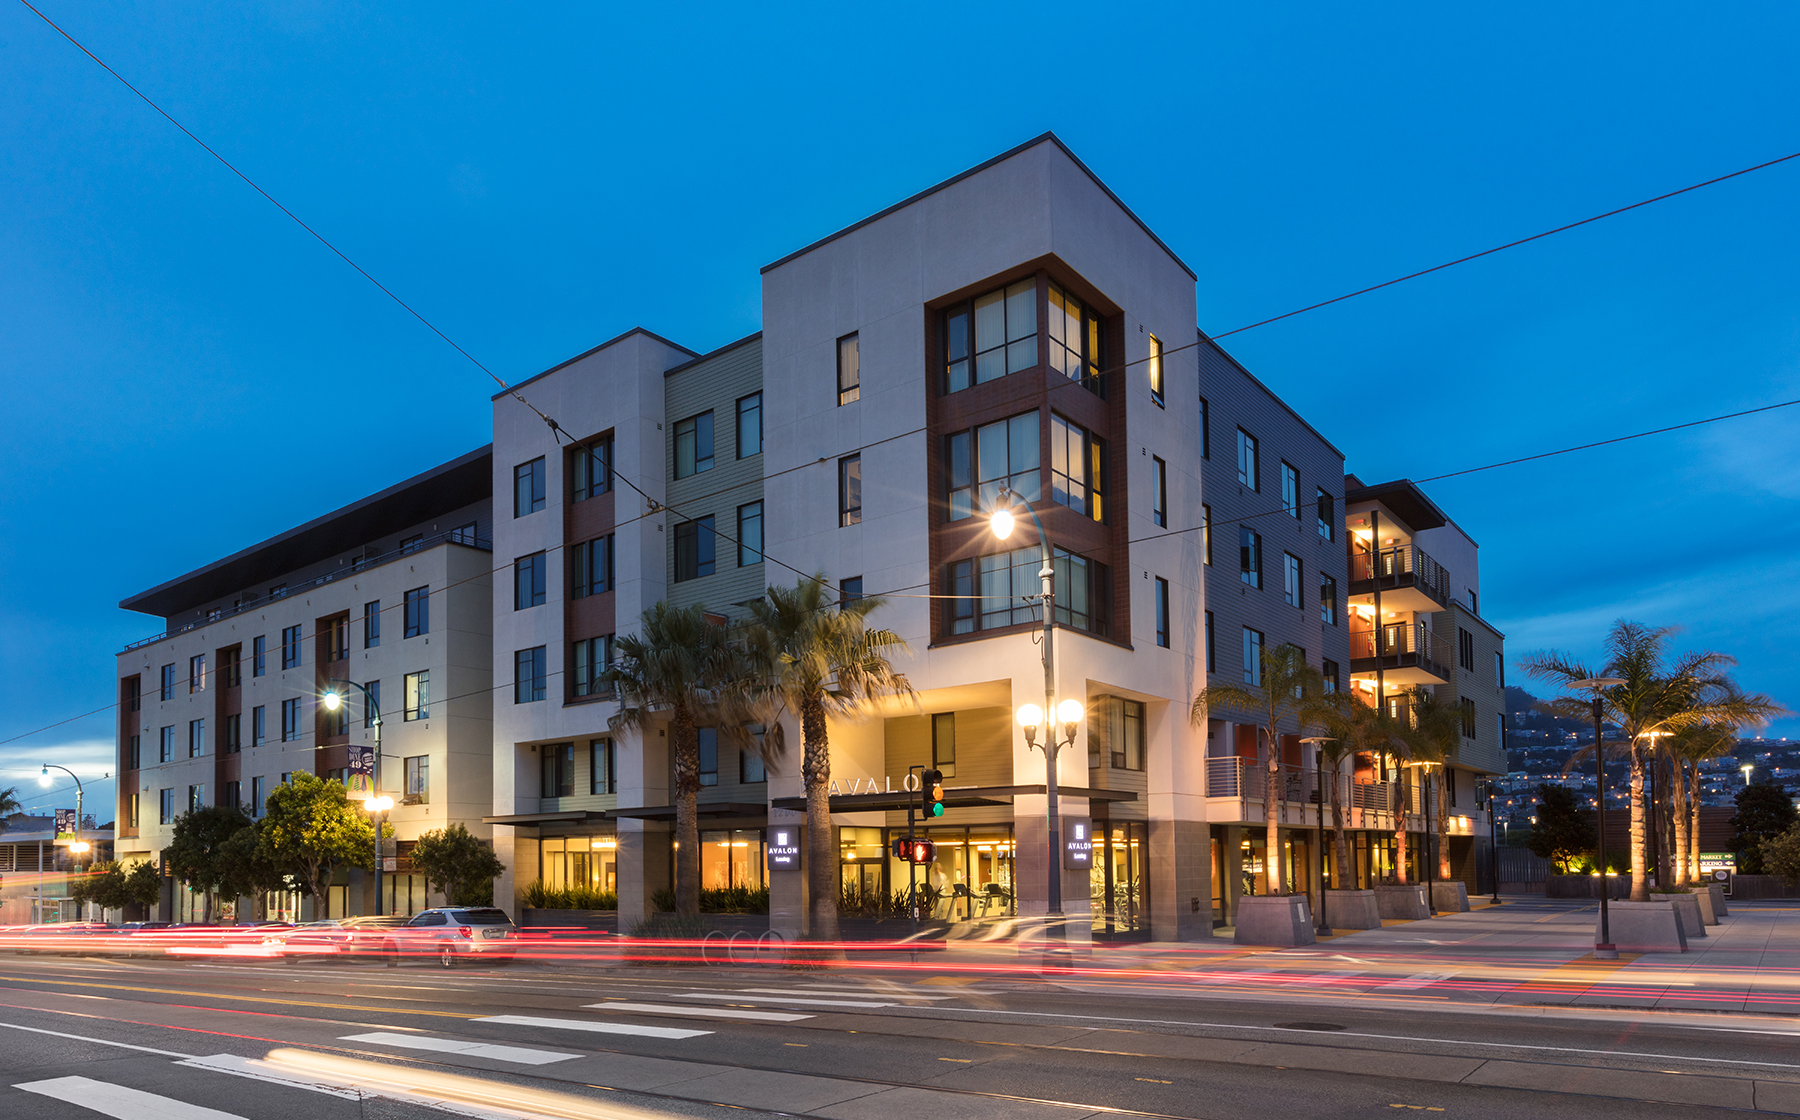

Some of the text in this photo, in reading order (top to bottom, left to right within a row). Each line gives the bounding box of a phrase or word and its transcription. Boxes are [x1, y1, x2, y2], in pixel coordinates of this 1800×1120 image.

[349, 760, 362, 769] 49
[829, 773, 919, 797] AVALO
[1068, 842, 1092, 850] AVALON
